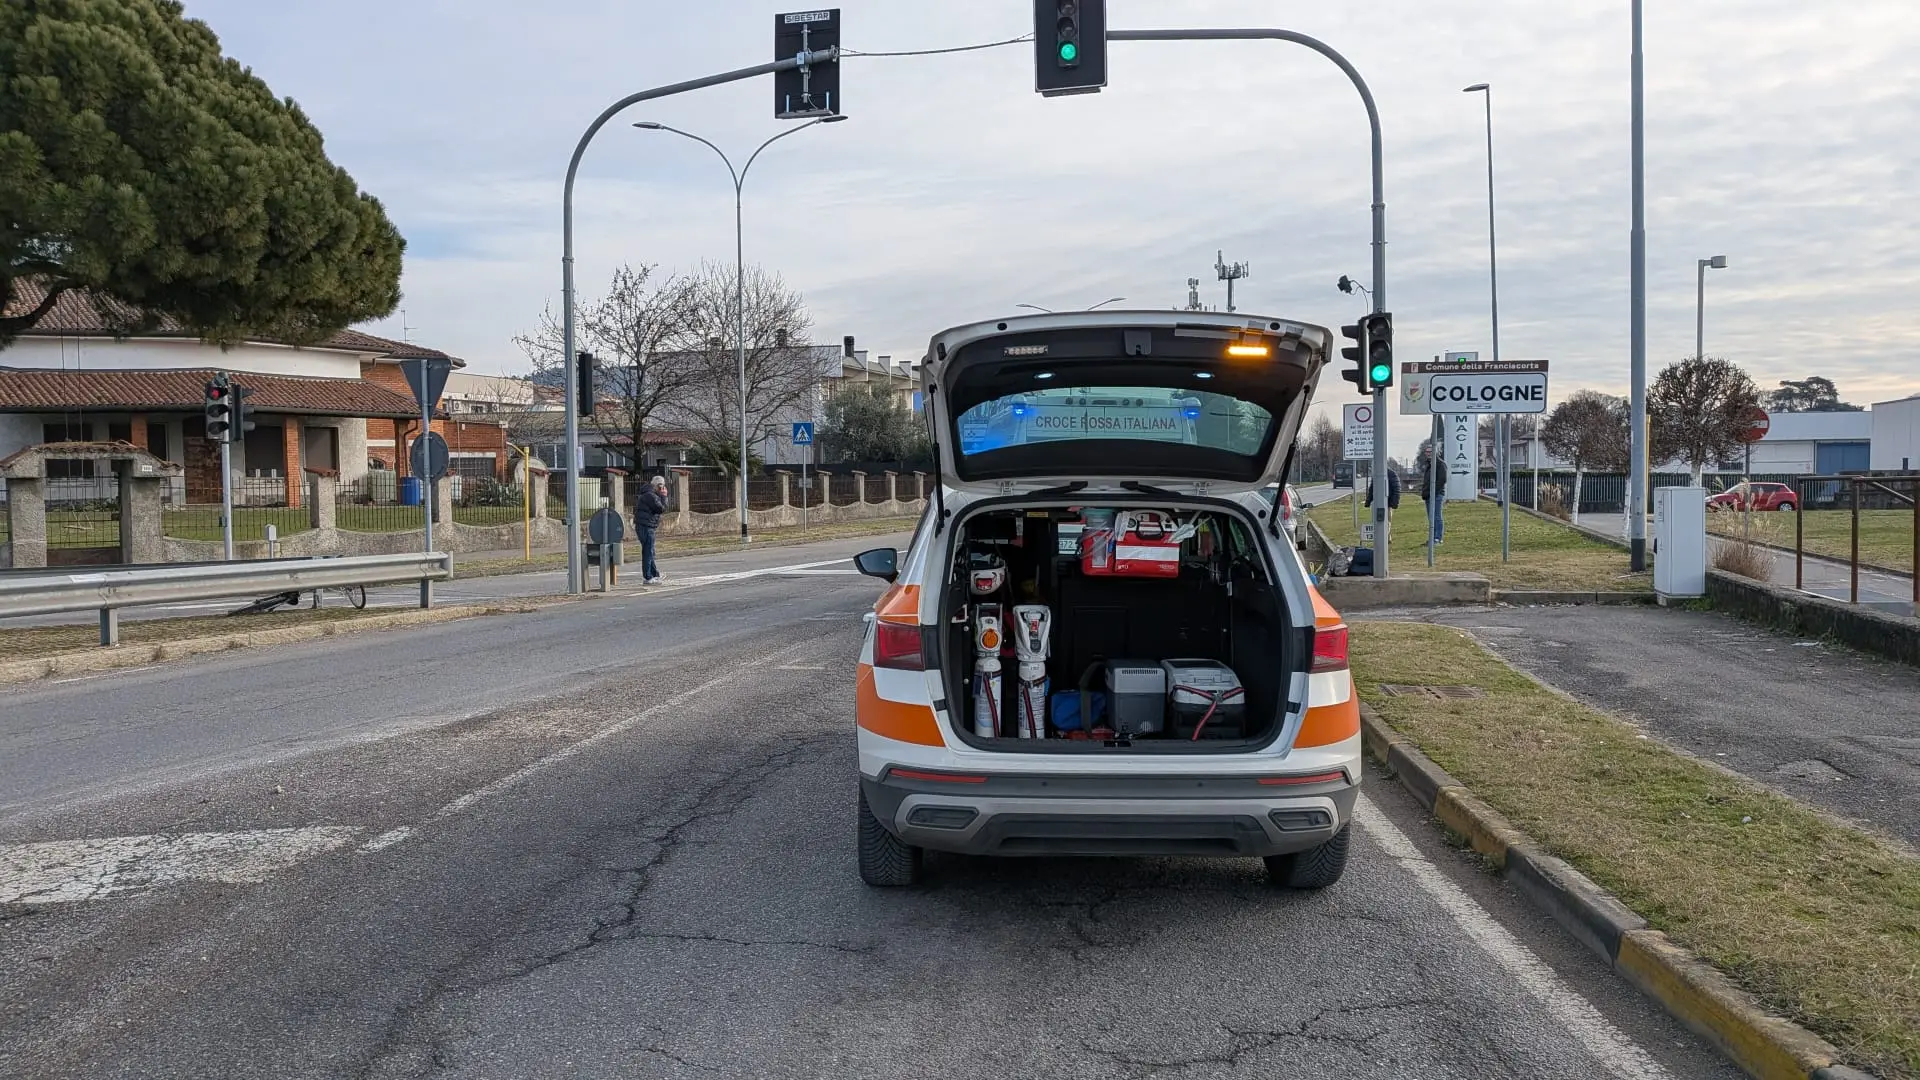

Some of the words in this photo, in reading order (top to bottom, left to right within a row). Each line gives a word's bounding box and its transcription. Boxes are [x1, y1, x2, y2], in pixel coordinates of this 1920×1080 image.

[785, 12, 829, 23] SIBESTAR
[1461, 362, 1482, 370] della
[1484, 362, 1539, 370] Franciacorta
[1432, 385, 1543, 402] COLOGNE
[1035, 416, 1076, 428] CROCE
[1080, 416, 1121, 429] ROSSA
[1124, 417, 1176, 429] ITALIANA
[1455, 415, 1467, 460] MACIA
